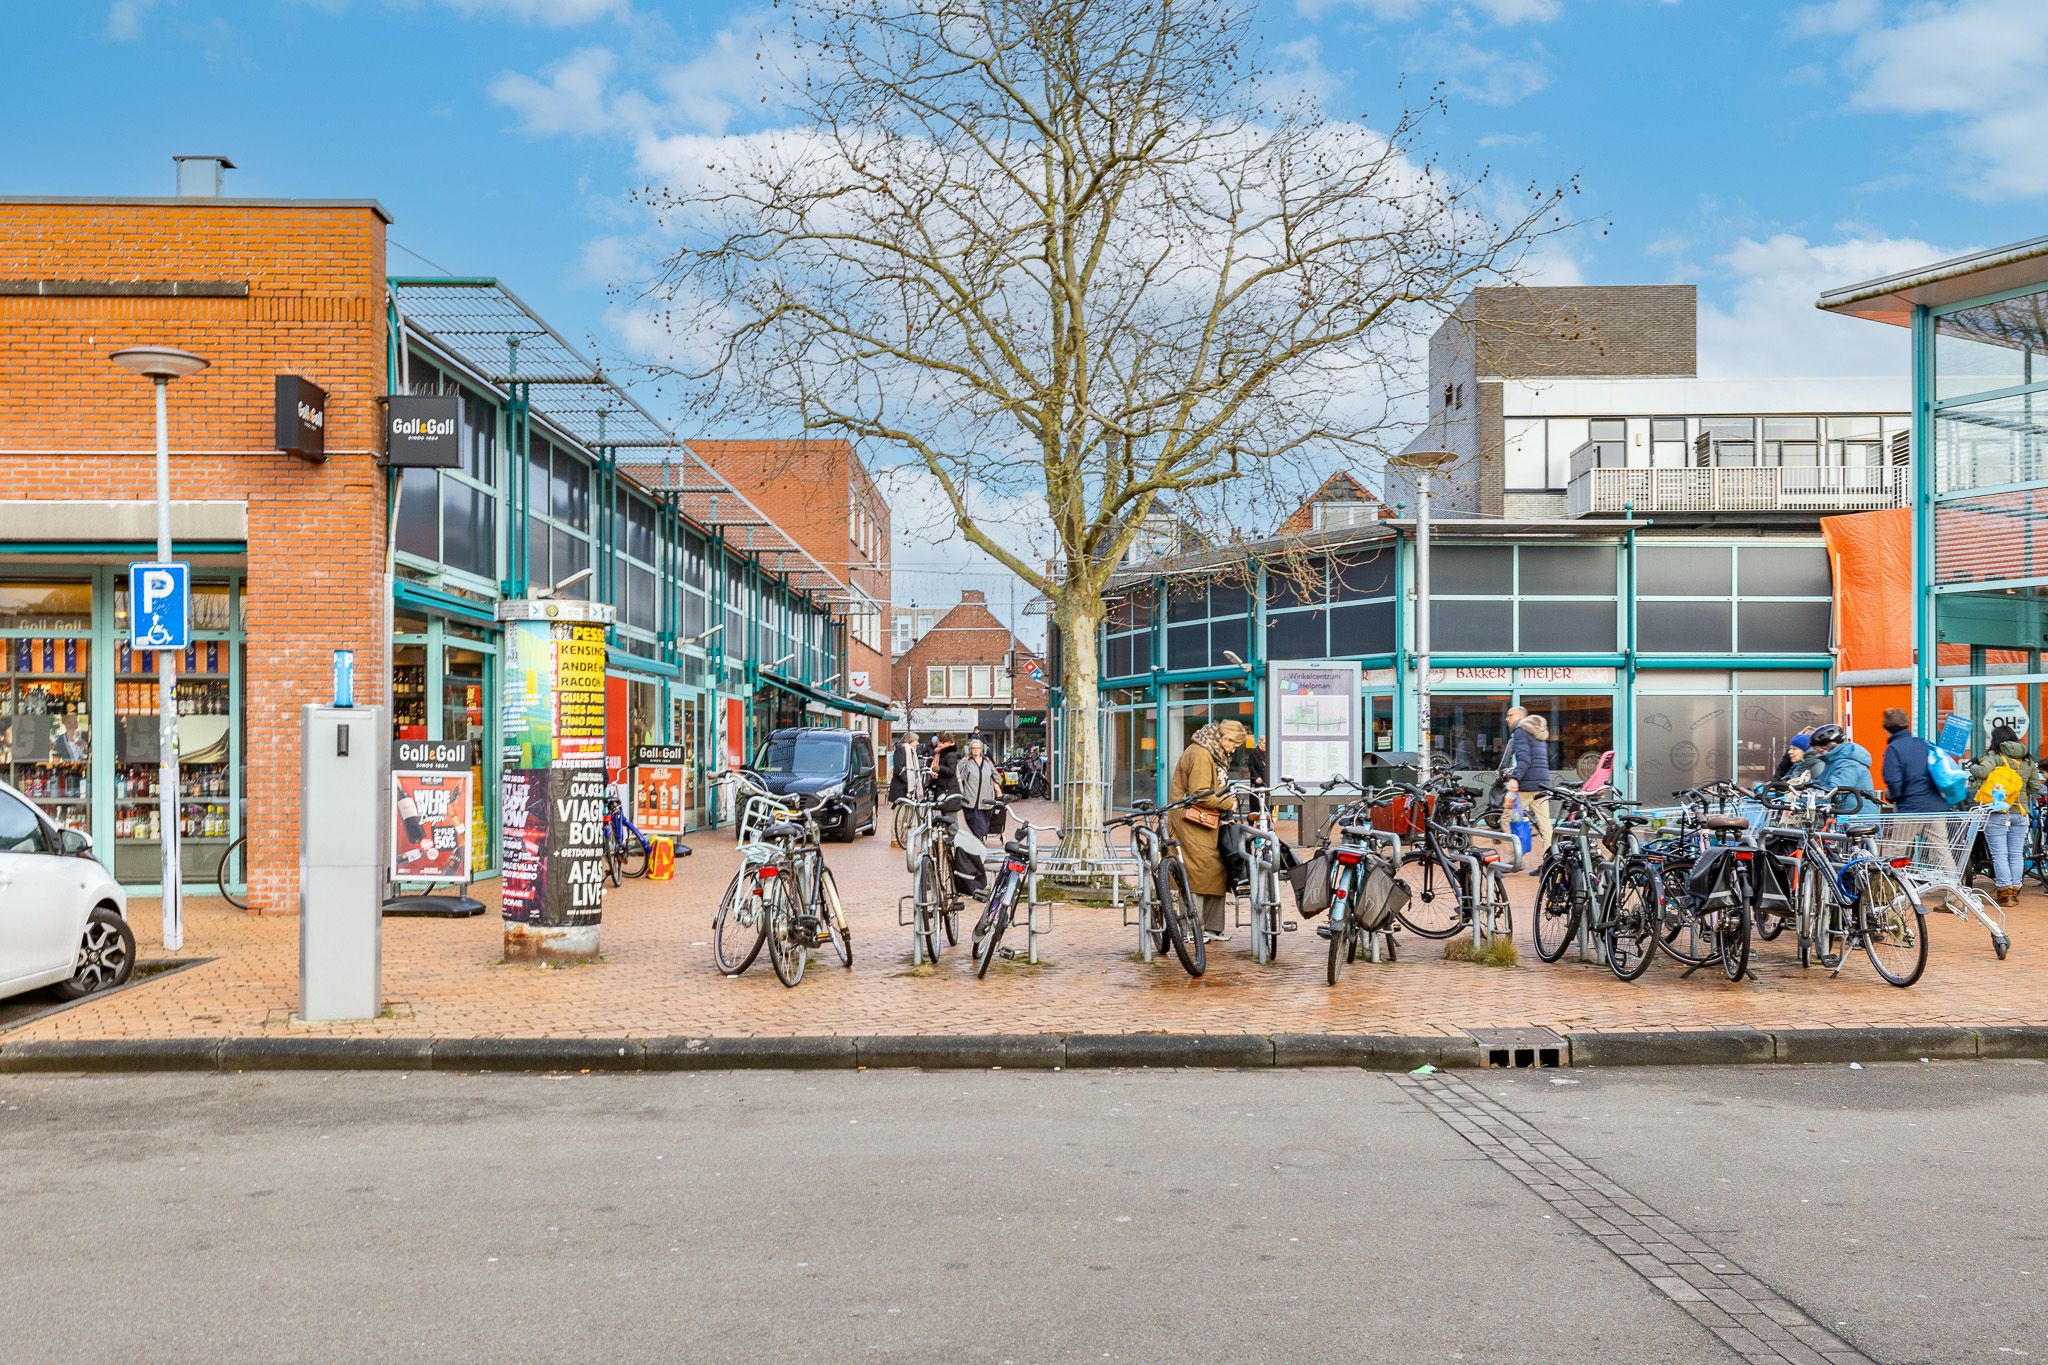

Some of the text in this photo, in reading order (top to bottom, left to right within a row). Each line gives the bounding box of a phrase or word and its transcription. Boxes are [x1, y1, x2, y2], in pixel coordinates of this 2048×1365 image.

[393, 418, 454, 435] Gall&Gall
[143, 570, 175, 614] P
[1288, 672, 1342, 680] Winkelcentrum
[1299, 682, 1331, 690] Helpman
[1018, 716, 1037, 724] garit
[400, 744, 465, 762] Gall&Gall
[640, 747, 681, 759] Gall&Gall
[434, 834, 457, 849] 50%
